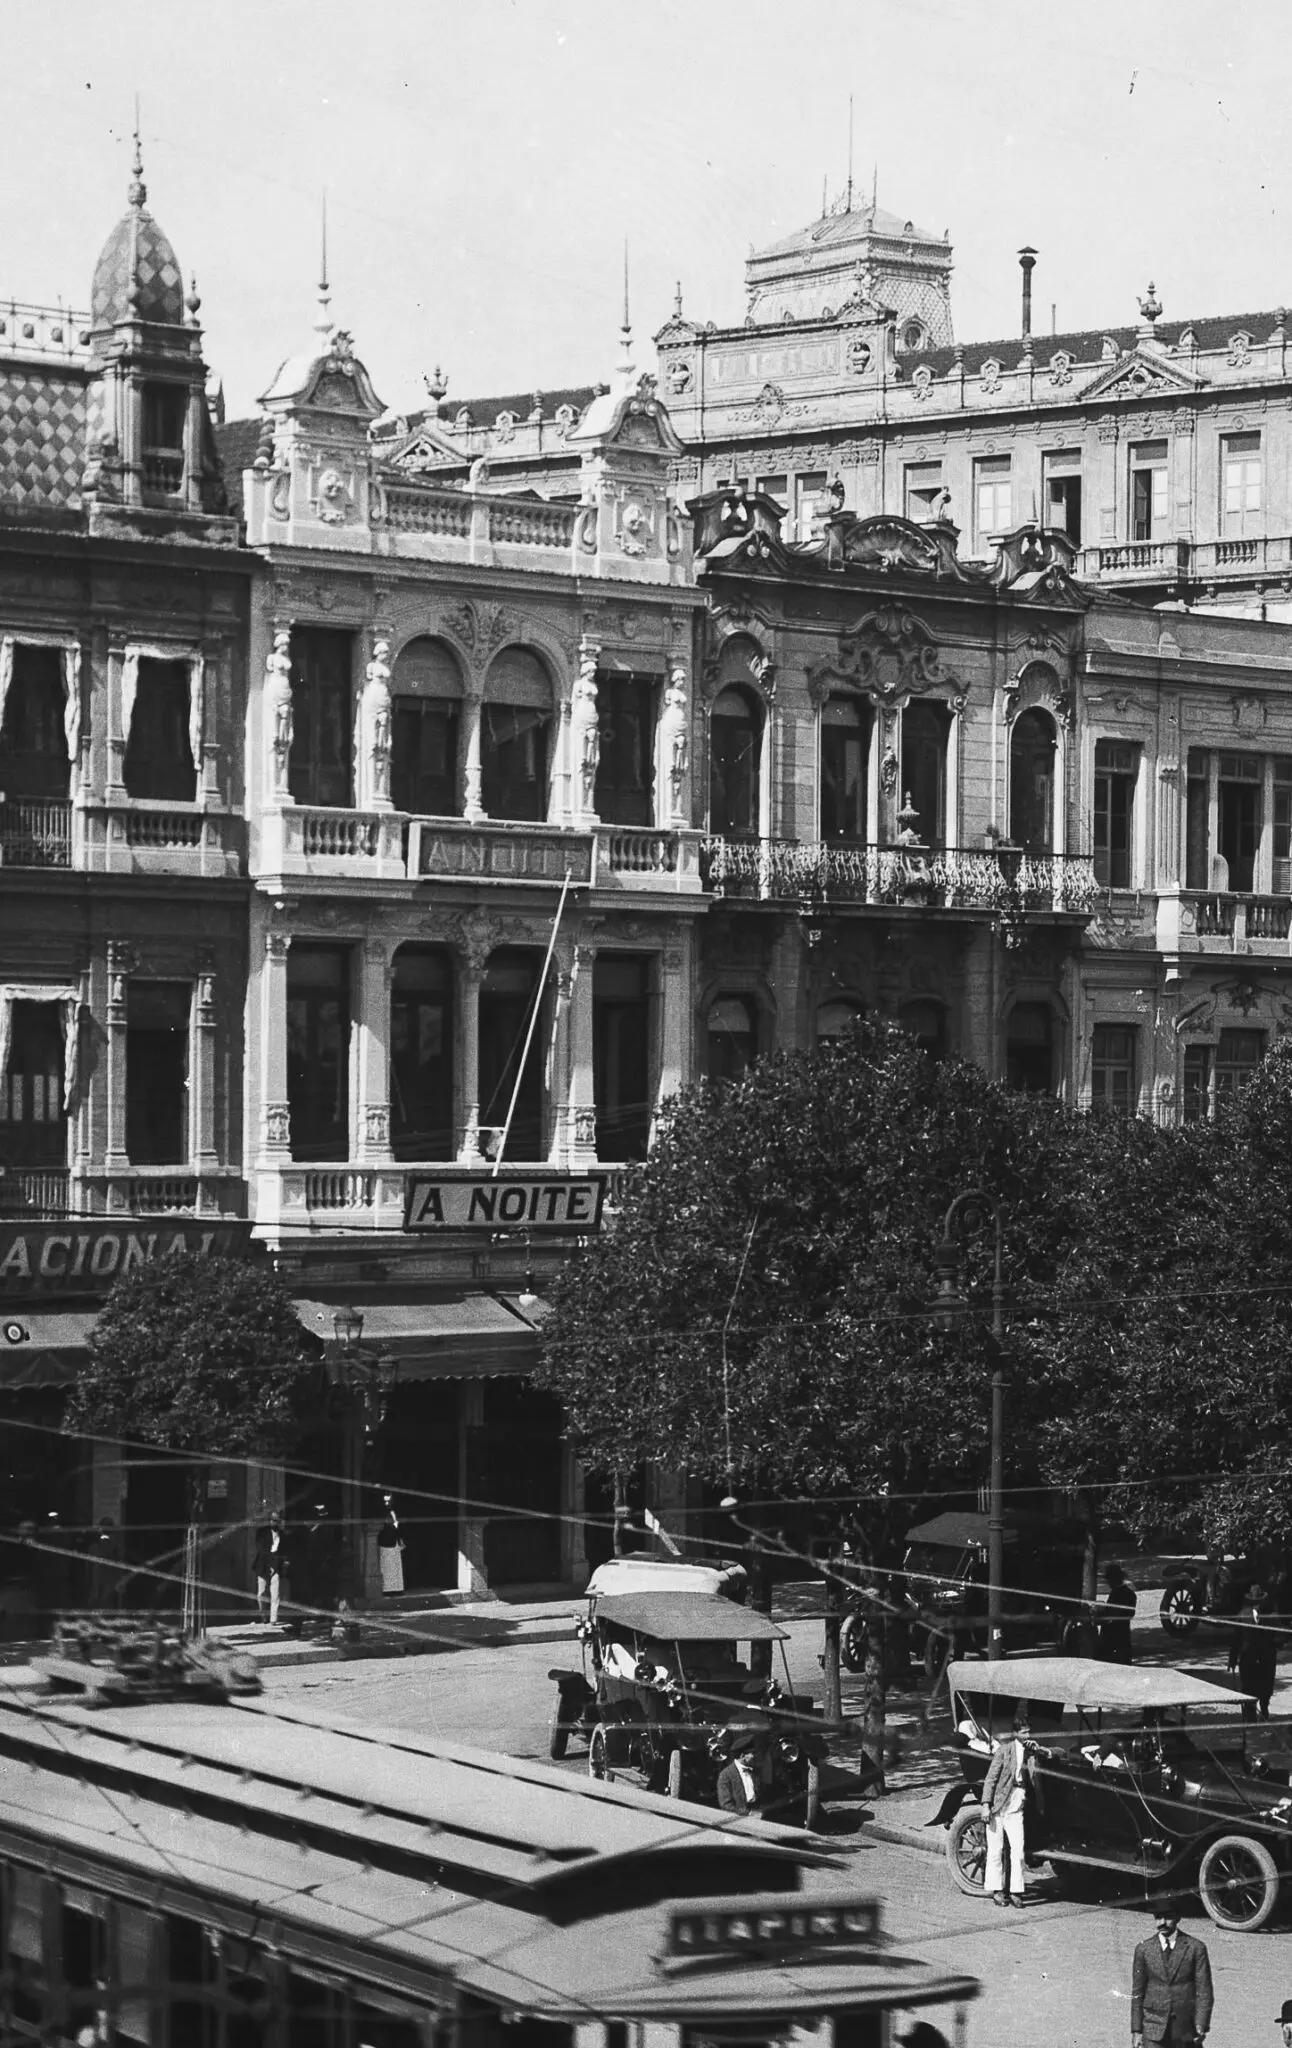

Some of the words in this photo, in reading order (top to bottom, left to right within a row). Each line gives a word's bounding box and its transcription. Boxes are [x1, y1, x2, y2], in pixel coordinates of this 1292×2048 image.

[428, 836, 450, 869] A
[416, 1186, 445, 1222] A
[467, 1186, 593, 1222] NOITE
[0, 1233, 215, 1277] ACION
